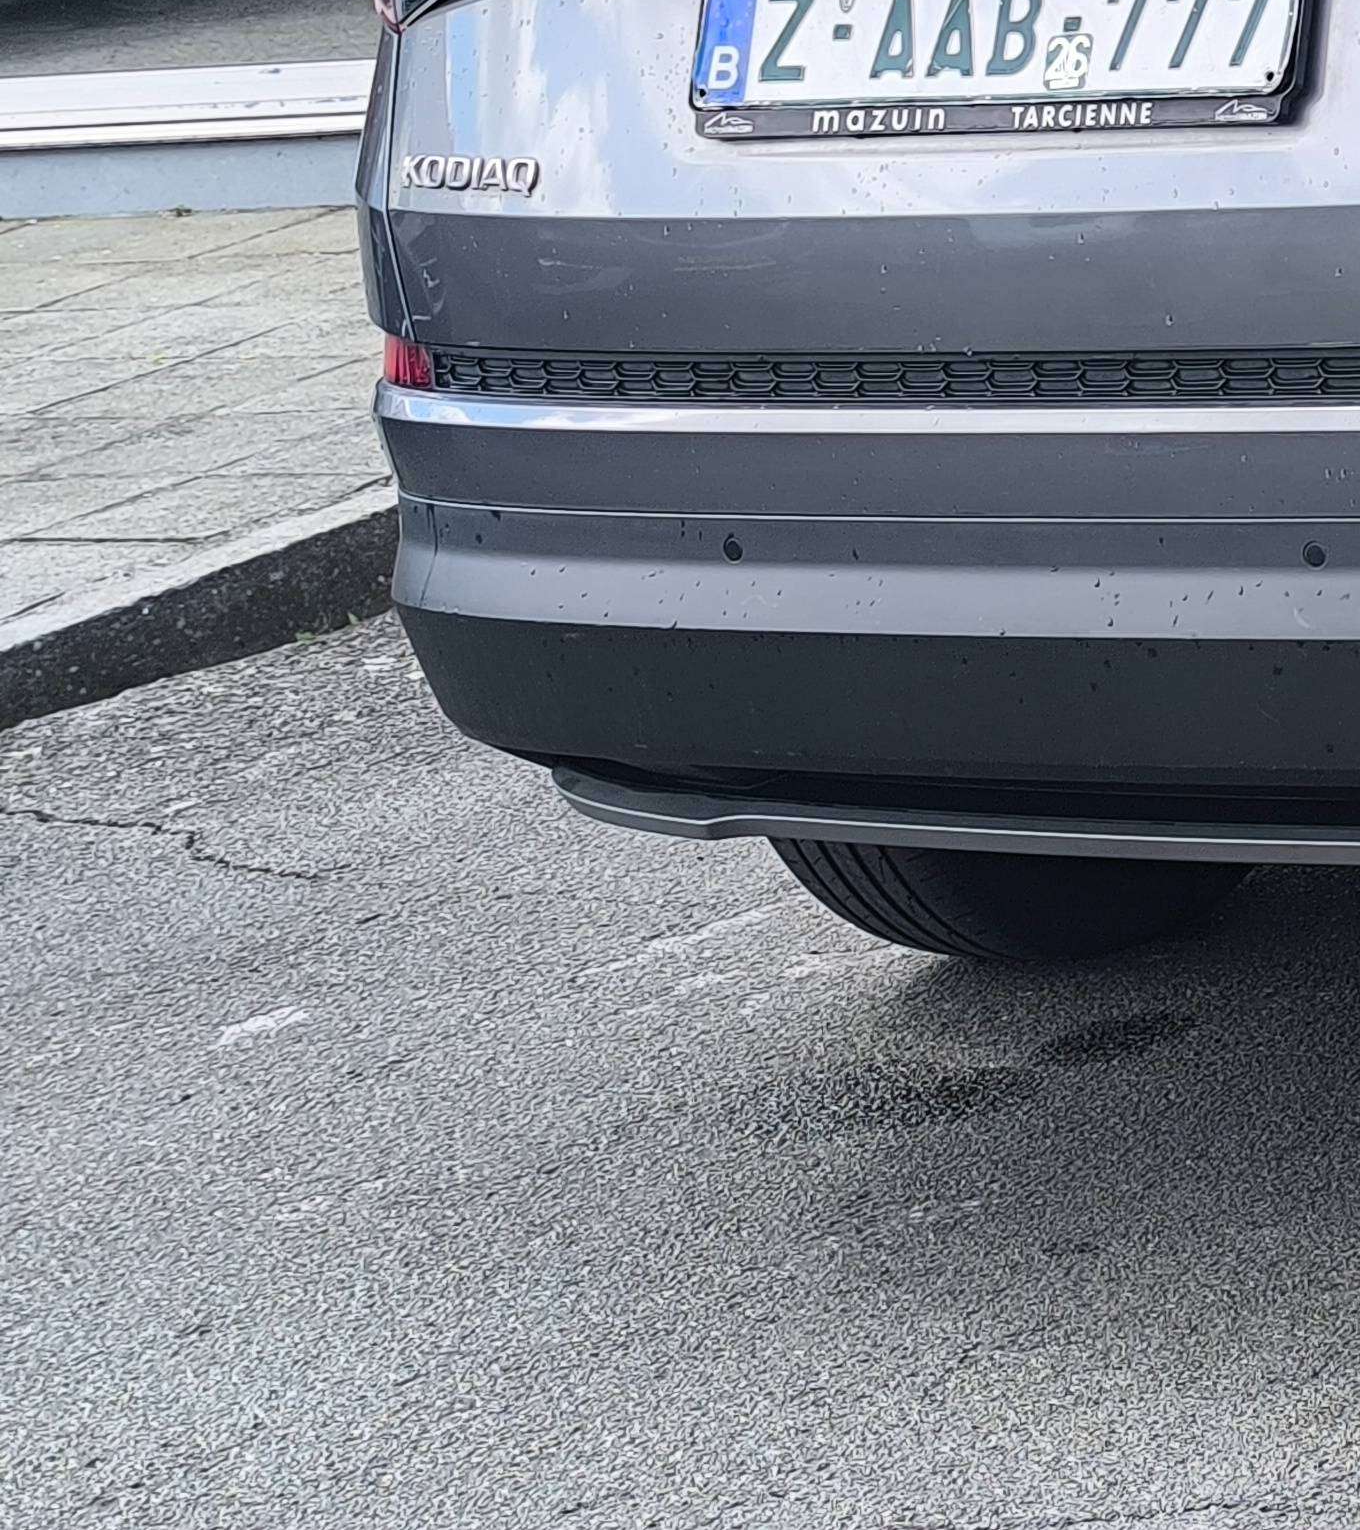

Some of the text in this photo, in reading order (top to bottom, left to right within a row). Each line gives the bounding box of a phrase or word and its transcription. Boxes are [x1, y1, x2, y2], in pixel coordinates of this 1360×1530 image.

[707, 45, 741, 90] B
[811, 101, 1153, 134] mazuin TARCIENNE
[401, 154, 540, 198] KODIAQ
